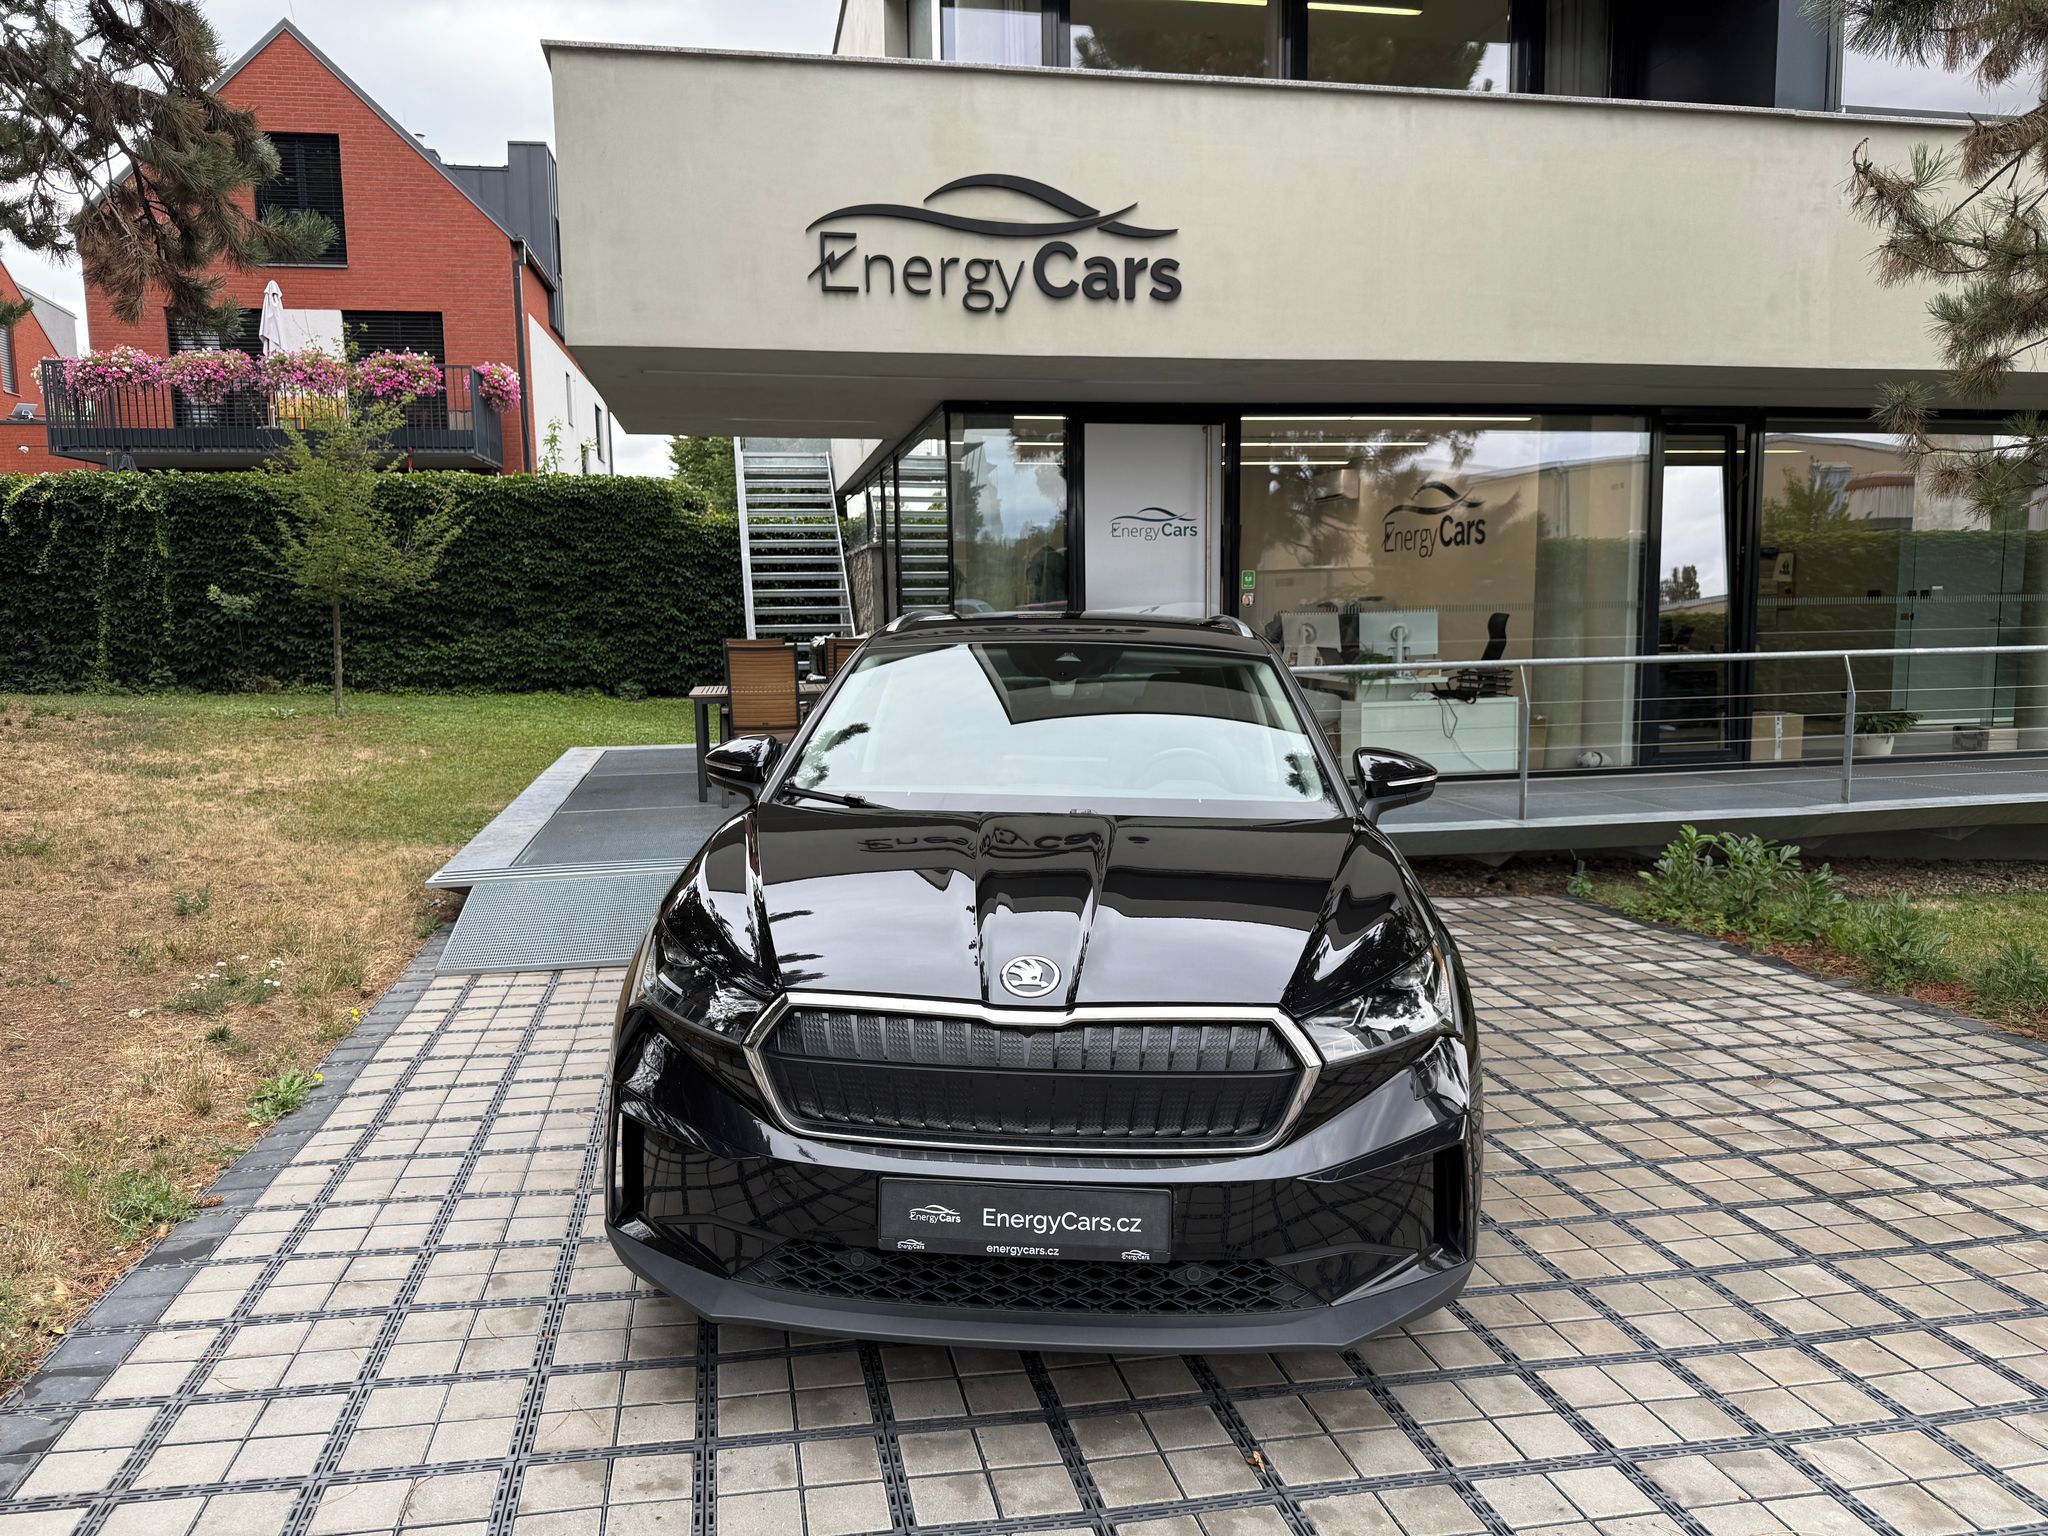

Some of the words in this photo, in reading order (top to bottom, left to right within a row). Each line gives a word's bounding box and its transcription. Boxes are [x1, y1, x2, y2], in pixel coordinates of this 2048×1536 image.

[808, 231, 1182, 313] EnergyCars
[1110, 522, 1198, 541] EnergyCars
[1382, 515, 1486, 558] EnergyCars
[909, 1211, 961, 1224] EnergyCars
[982, 1207, 1142, 1235] EnergyCars.cz
[986, 1244, 1060, 1257] energycars.cz
